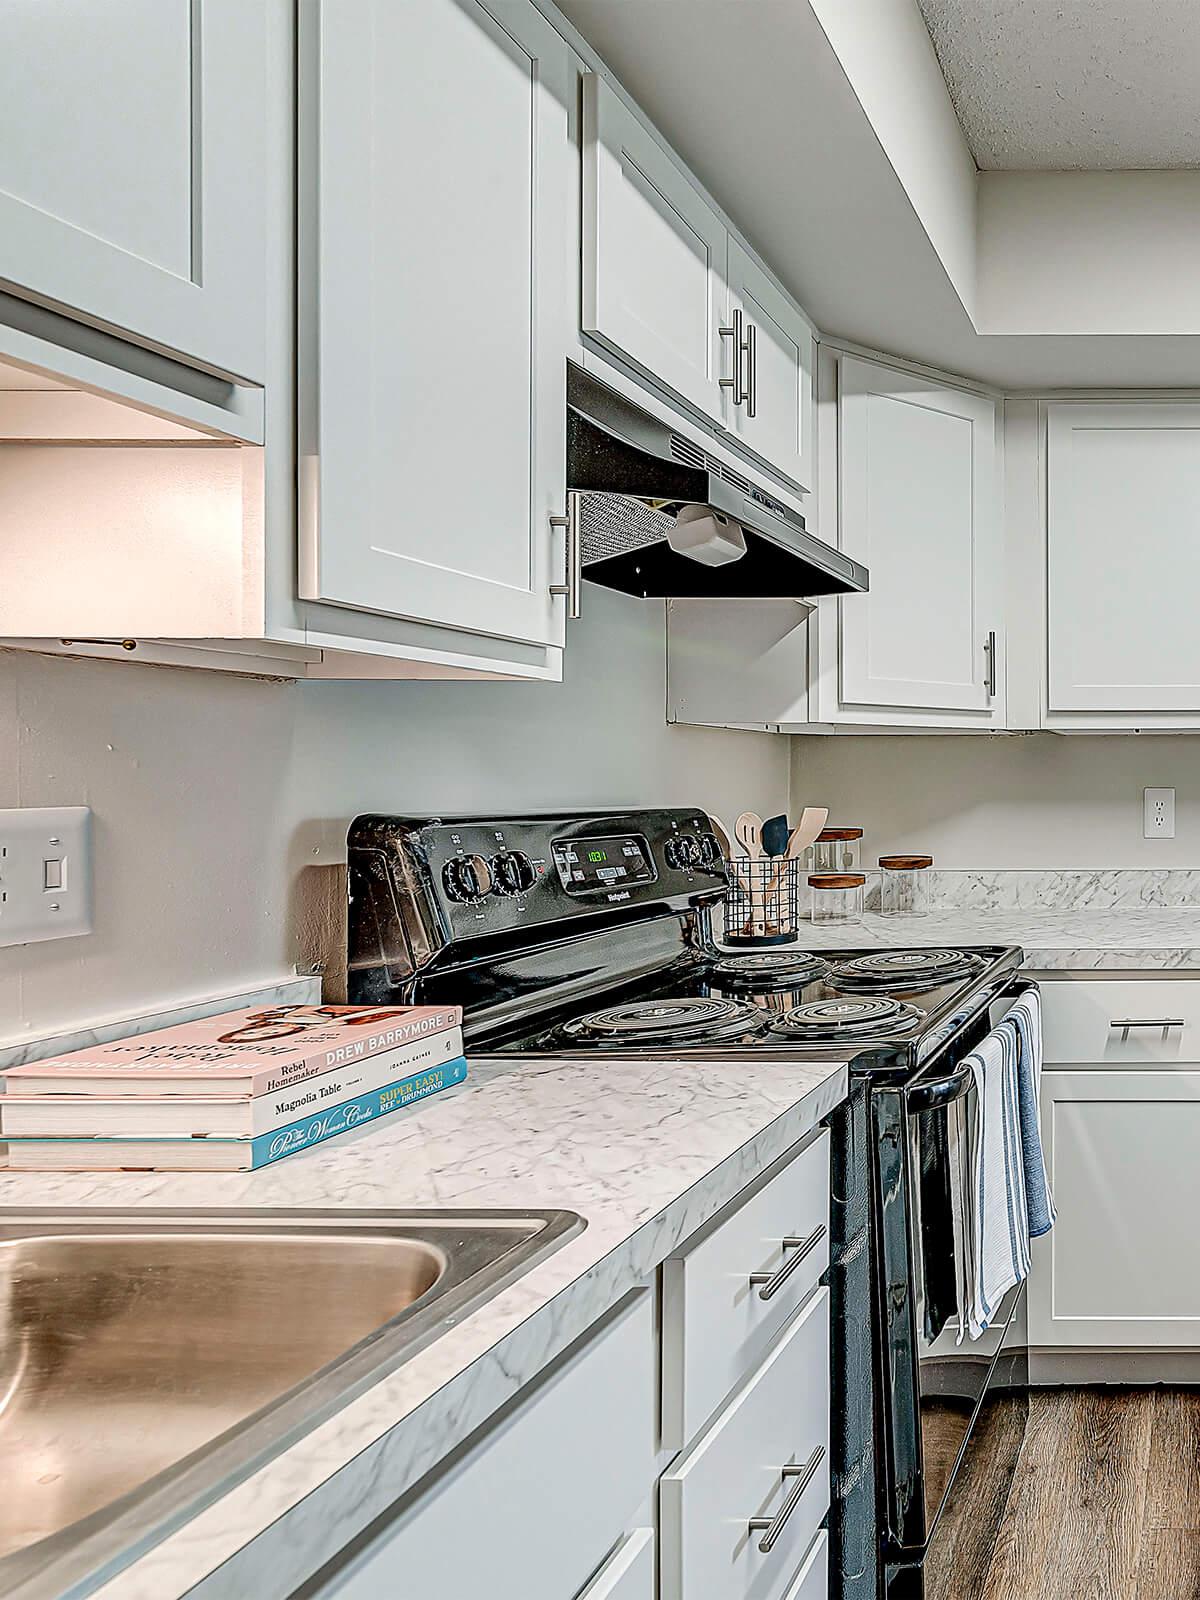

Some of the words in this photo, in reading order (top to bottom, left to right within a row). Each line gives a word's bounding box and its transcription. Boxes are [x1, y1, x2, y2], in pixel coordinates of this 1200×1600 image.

[326, 1041, 365, 1065] DREW
[368, 1015, 443, 1050] BARRYMORE
[267, 1067, 320, 1091] Homemaker
[281, 1060, 306, 1076] Rebel
[275, 1092, 317, 1115] Magnolia
[319, 1083, 342, 1098] Table
[379, 1099, 396, 1112] REE
[401, 1080, 443, 1103] DRUMMOND
[380, 1083, 413, 1104] SUPER
[415, 1071, 443, 1088] EASY!
[268, 1131, 307, 1158] Pioneer
[307, 1109, 346, 1141] Woman
